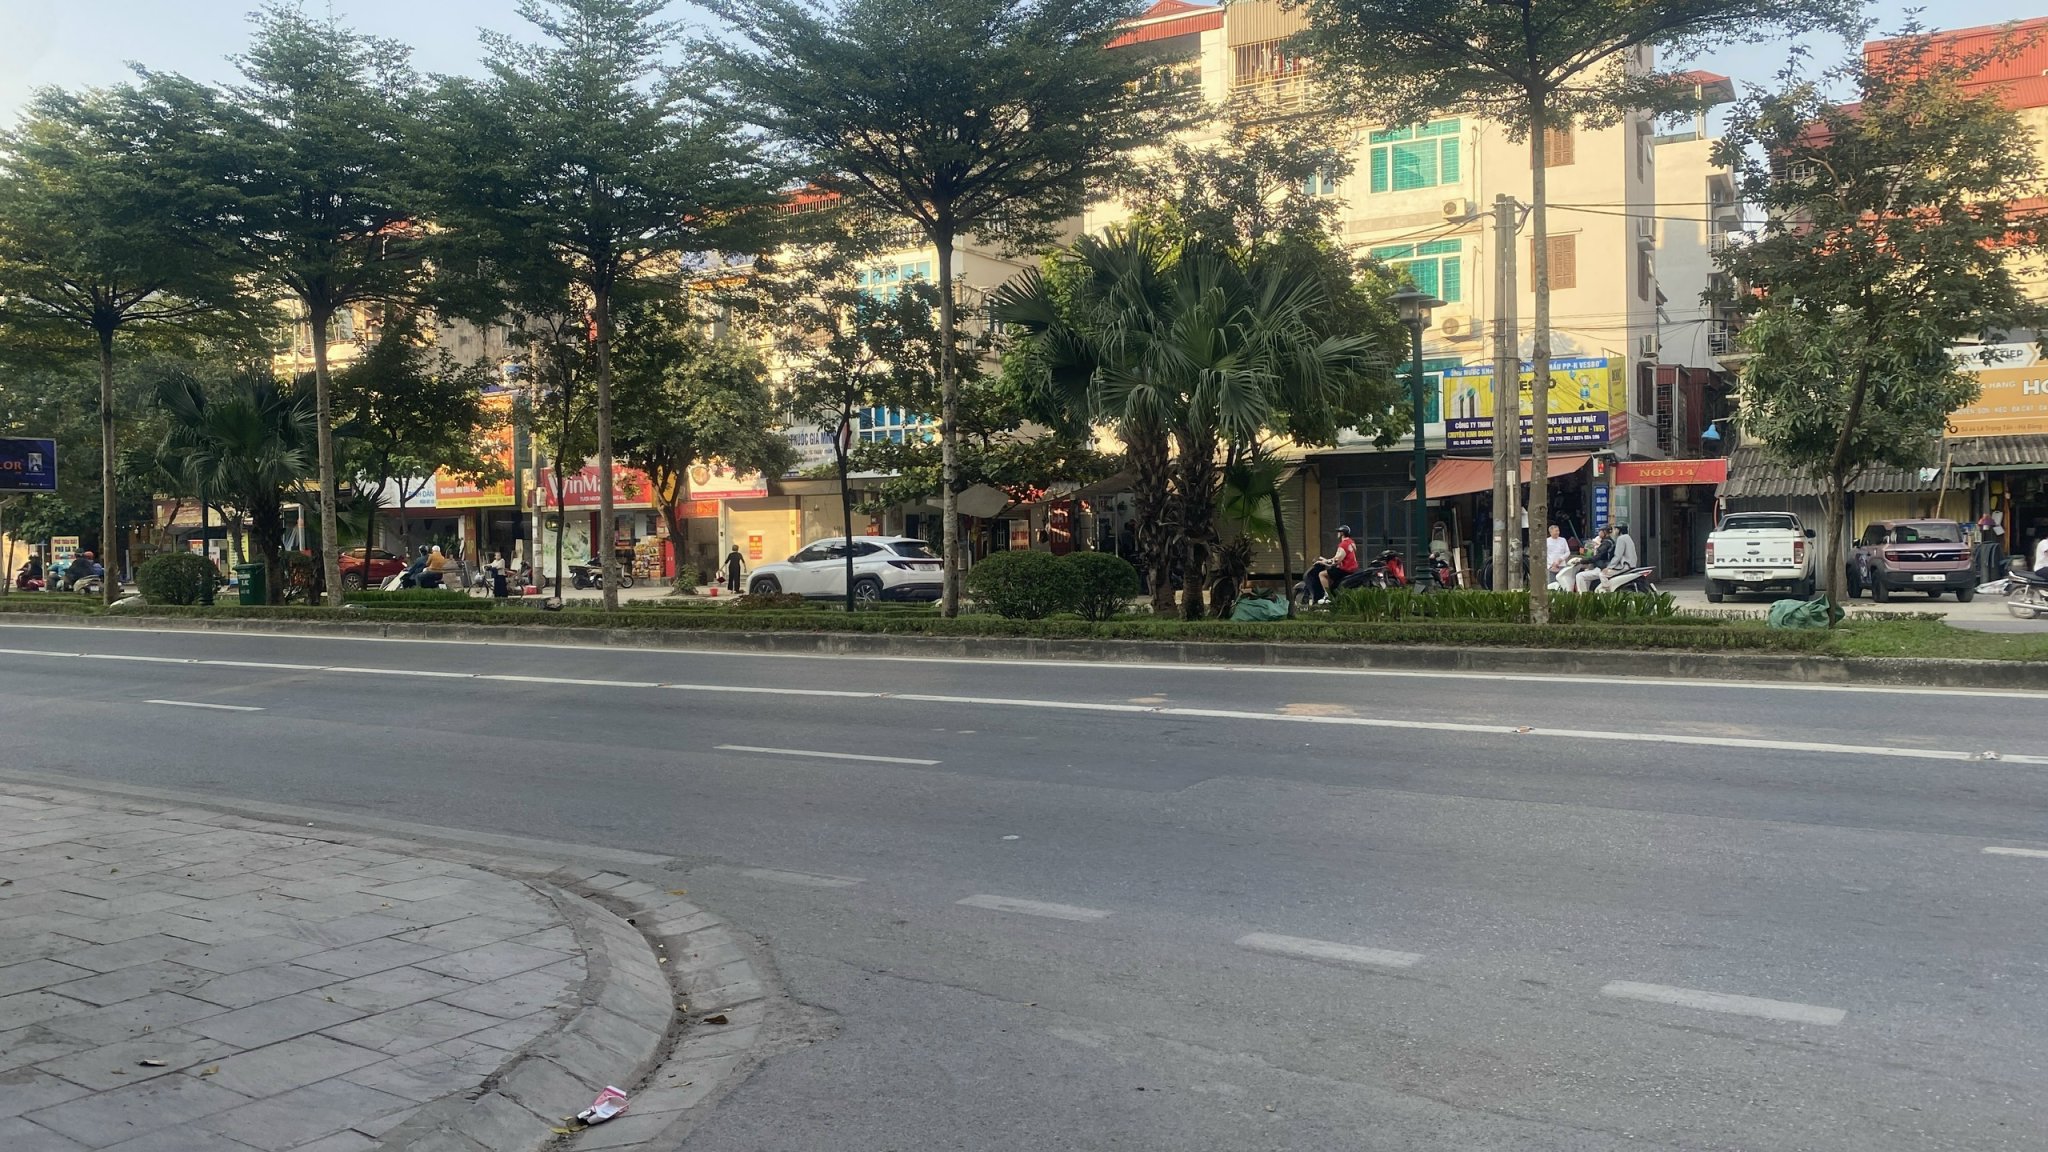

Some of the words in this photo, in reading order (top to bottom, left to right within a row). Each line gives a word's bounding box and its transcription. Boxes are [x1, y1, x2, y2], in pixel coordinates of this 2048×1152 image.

[1454, 421, 1469, 429] CÔNG
[1470, 421, 1476, 429] TY
[1574, 416, 1582, 424] AN
[1582, 414, 1597, 423] PHÁT
[1678, 468, 1695, 477] 14
